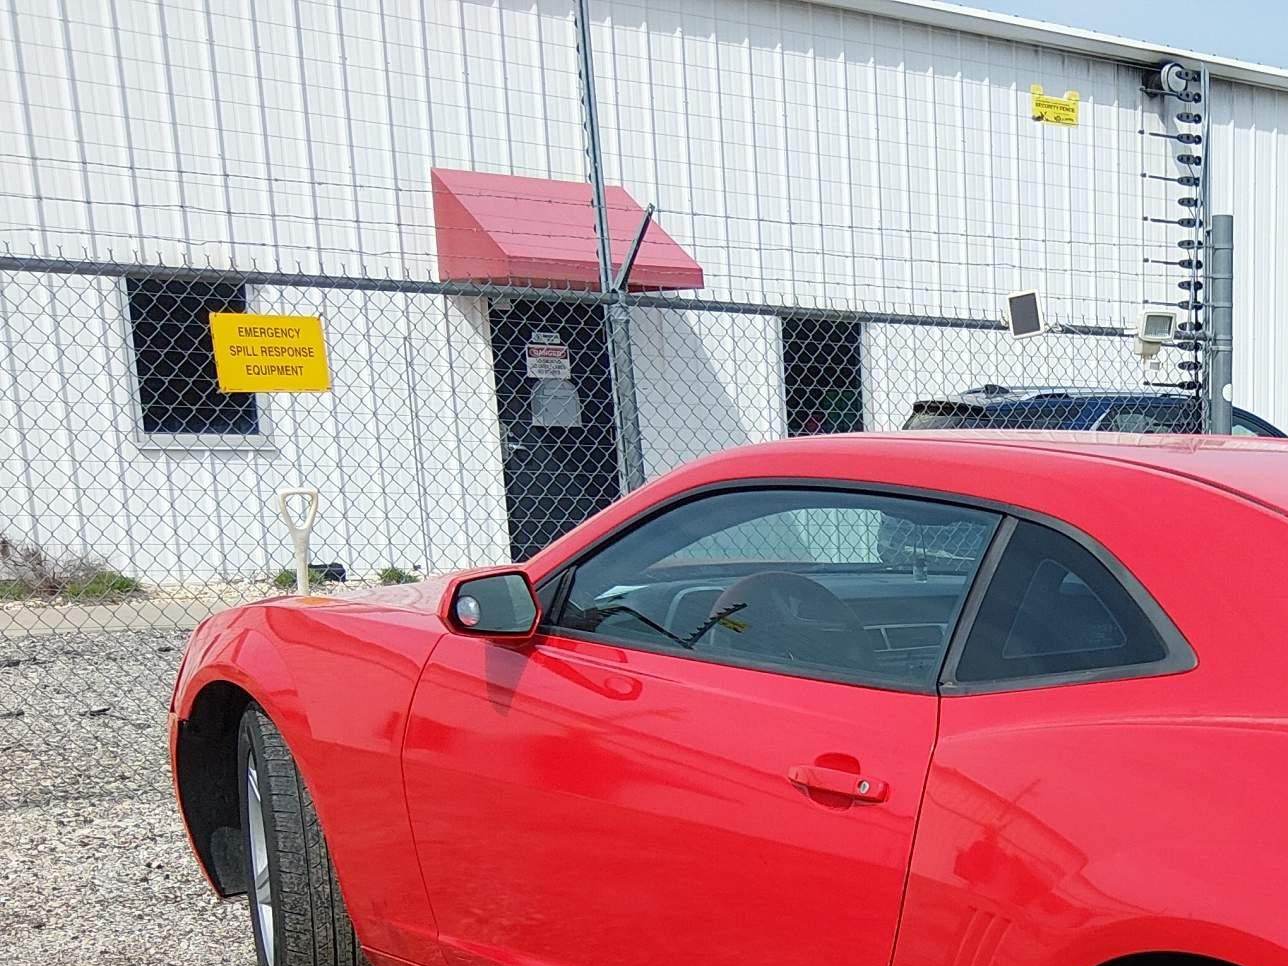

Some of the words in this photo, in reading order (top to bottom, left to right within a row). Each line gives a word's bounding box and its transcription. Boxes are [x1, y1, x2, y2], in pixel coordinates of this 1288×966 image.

[238, 326, 300, 338] EMERGENCY
[230, 345, 258, 357] SPILL
[260, 346, 314, 357] RESPONSE
[246, 364, 304, 376] EQUIPMENT
